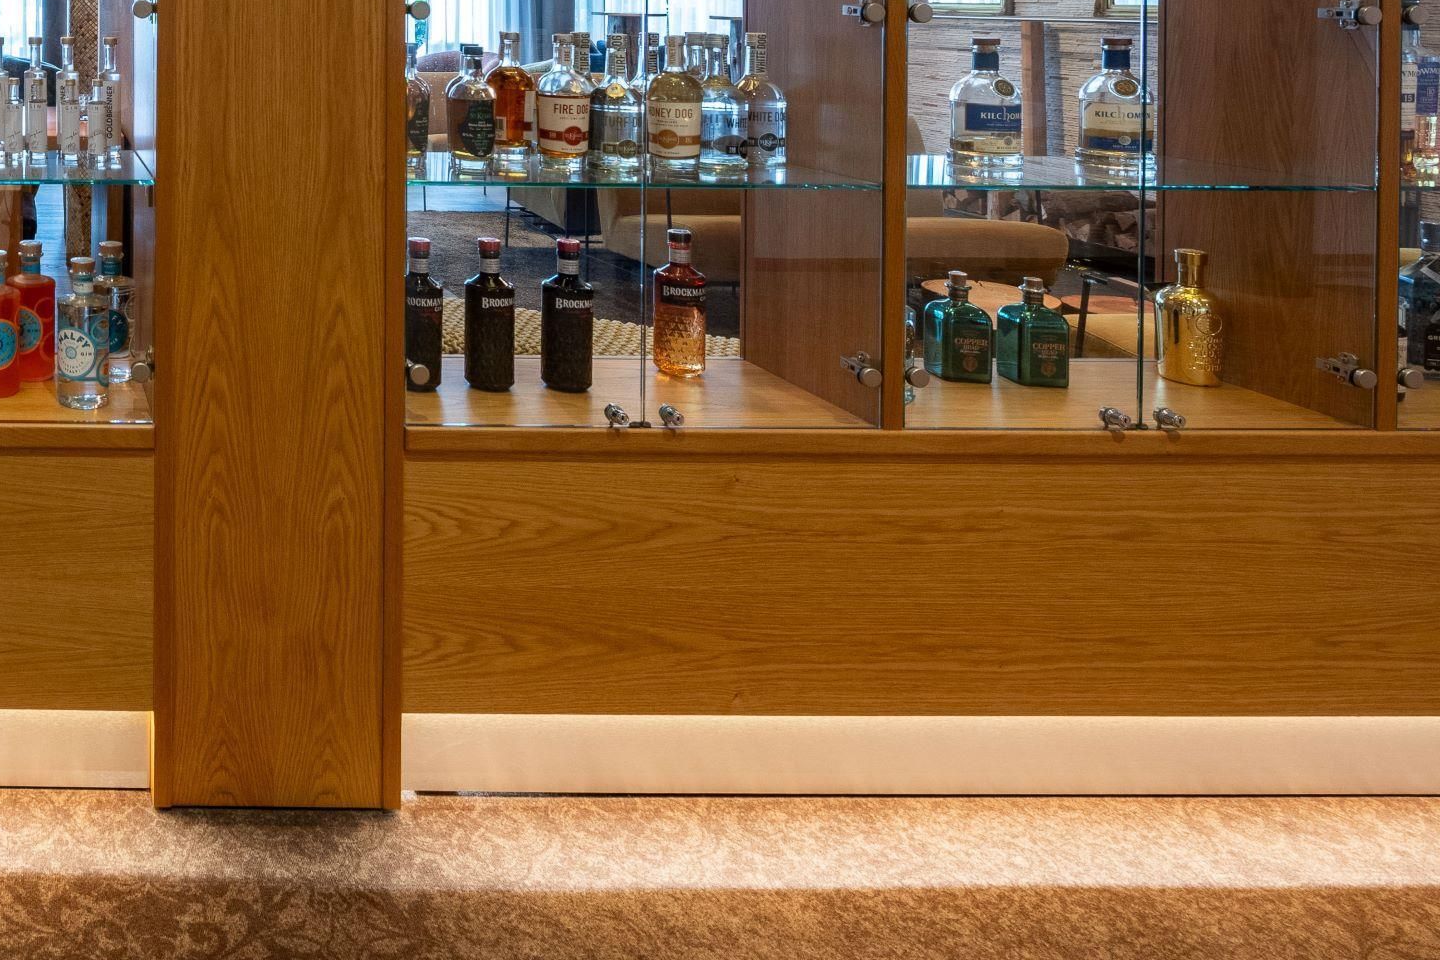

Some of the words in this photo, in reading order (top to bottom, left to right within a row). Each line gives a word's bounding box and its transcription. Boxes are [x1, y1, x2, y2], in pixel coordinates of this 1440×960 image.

[581, 33, 590, 48] DOG
[758, 34, 766, 48] DOG
[580, 51, 589, 71] TURF
[756, 49, 765, 73] WHITE
[553, 104, 574, 115] FIRE
[675, 108, 692, 118] DOG
[748, 112, 772, 121] WHITE
[954, 337, 989, 346] COPPER
[1032, 343, 1065, 351] COPPER
